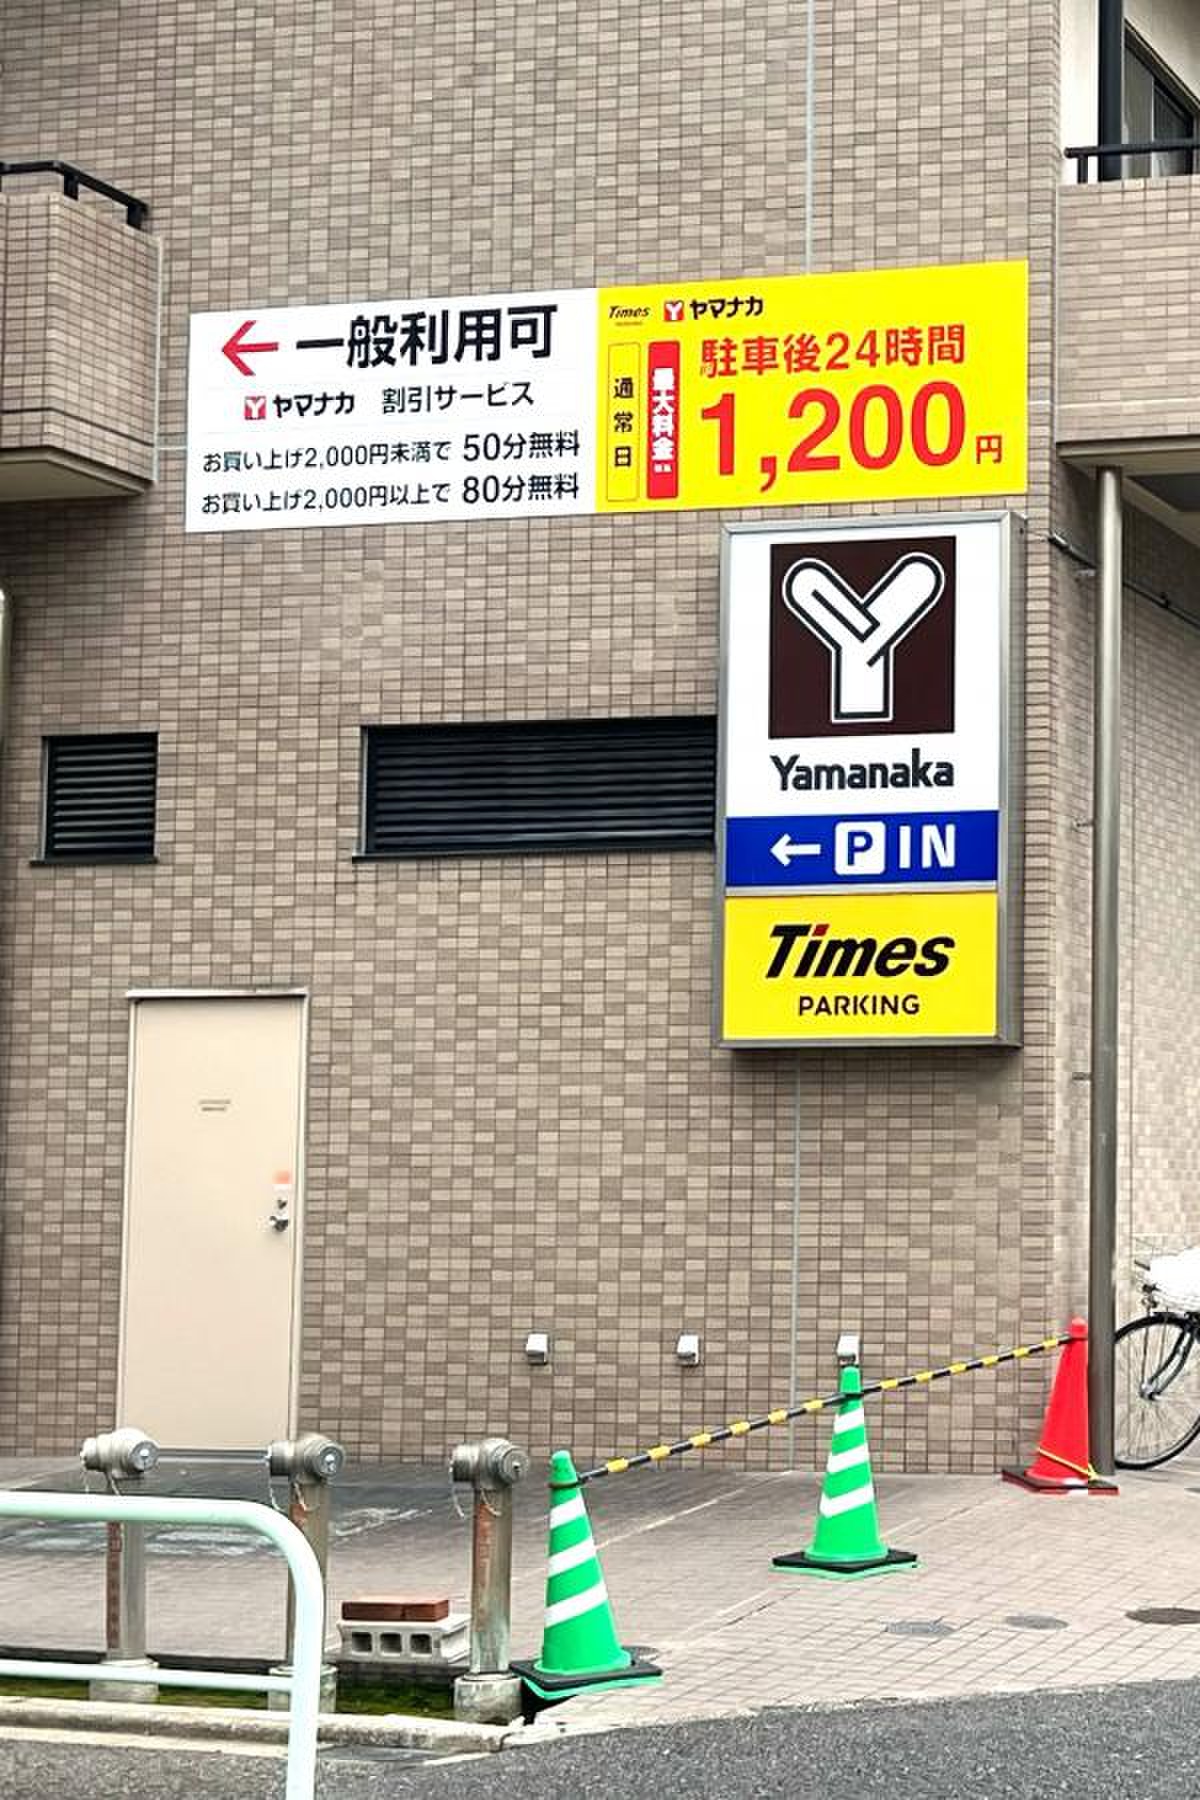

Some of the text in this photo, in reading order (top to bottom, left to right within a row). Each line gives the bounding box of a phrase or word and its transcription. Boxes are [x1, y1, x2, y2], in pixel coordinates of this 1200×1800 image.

[609, 305, 650, 319] Times
[690, 296, 764, 320] ヤマナカ
[296, 304, 558, 368] 一般利用可
[699, 324, 966, 378] 駐車後24時間
[273, 391, 355, 418] ヤマナカ
[382, 381, 535, 415] 割引サービス
[613, 377, 634, 467] 通常日
[463, 429, 580, 462] 50分無料
[462, 472, 579, 504] 80分無料
[770, 747, 955, 792] Yamanaka
[898, 824, 956, 869] IN
[765, 923, 956, 980] Times
[799, 993, 921, 1017] PARKING
